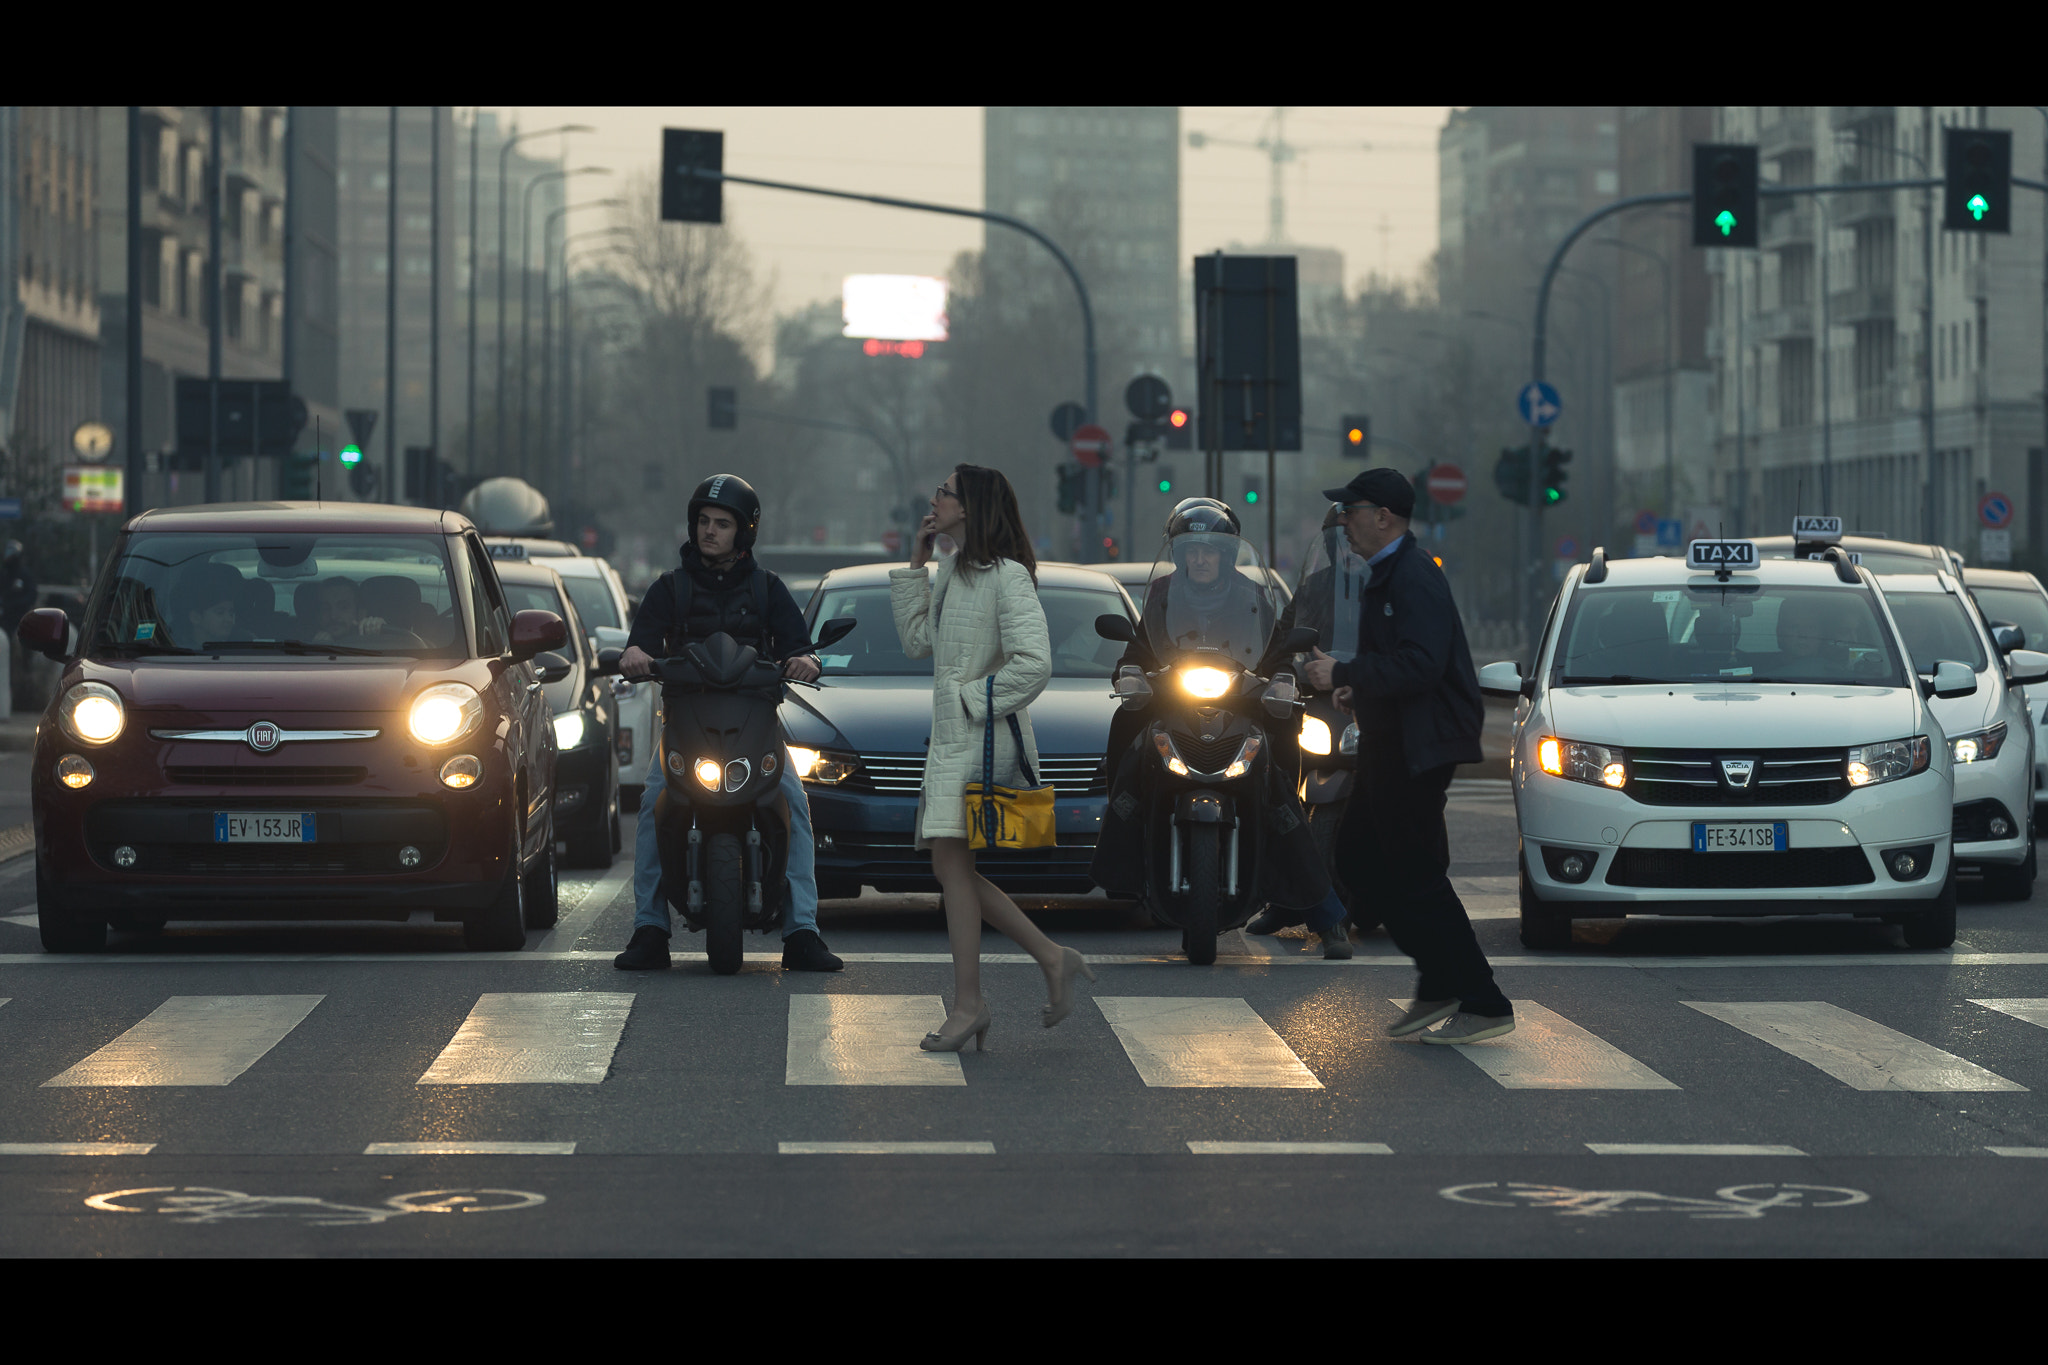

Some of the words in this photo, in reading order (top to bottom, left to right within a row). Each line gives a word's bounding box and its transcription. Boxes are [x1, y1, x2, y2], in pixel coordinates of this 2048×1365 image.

[1801, 518, 1837, 531] TAXI
[1695, 545, 1749, 561] TAXI
[256, 730, 272, 742] FIAT
